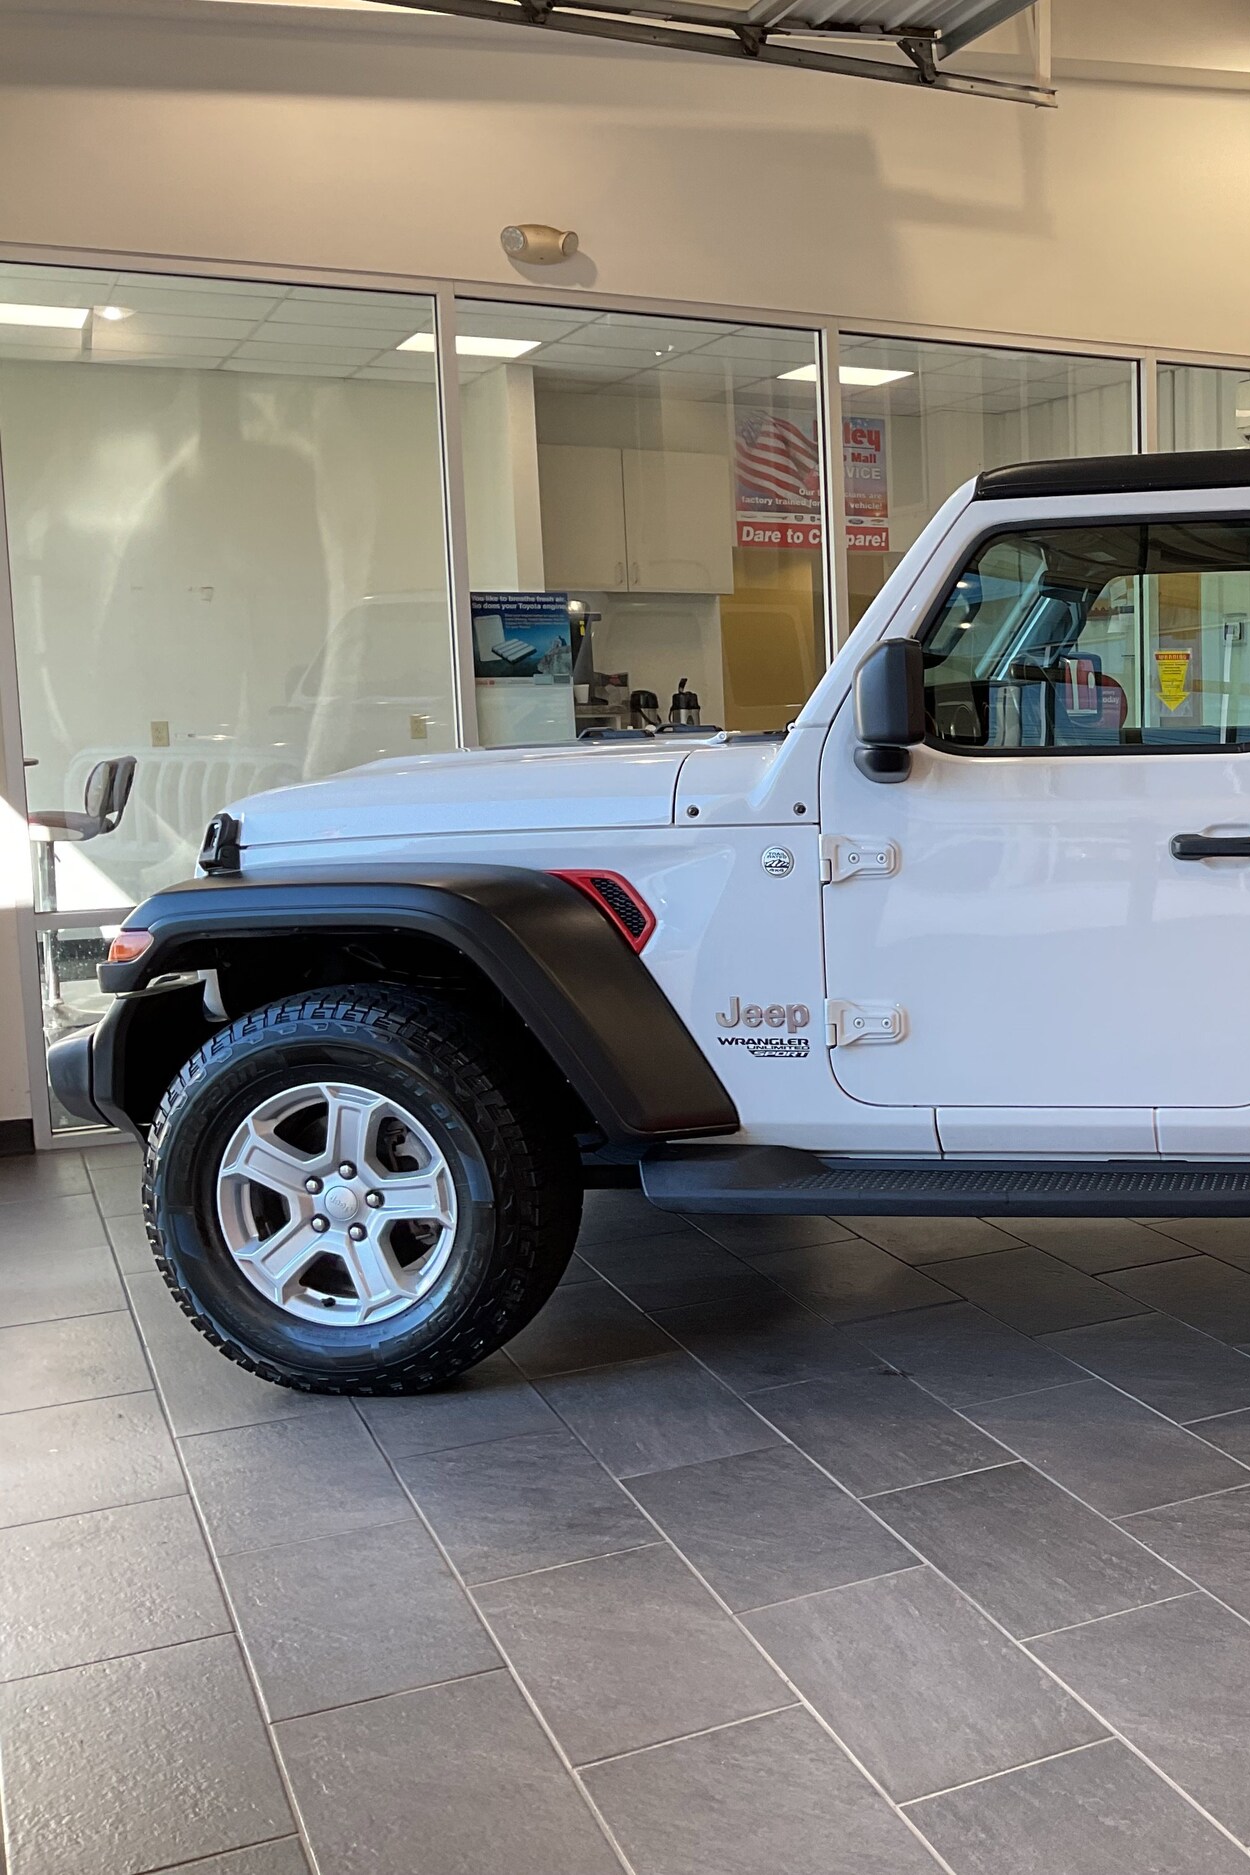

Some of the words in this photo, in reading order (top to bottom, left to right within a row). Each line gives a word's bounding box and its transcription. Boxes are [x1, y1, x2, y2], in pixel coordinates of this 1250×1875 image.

[851, 452, 877, 464] Mall
[799, 488, 815, 496] Our
[741, 496, 772, 506] factory
[776, 497, 807, 507] trained
[742, 526, 781, 543] Dare
[787, 529, 804, 544] to
[808, 528, 887, 547] Cpare!
[518, 603, 542, 611] Toyota
[715, 996, 810, 1034] Jeep
[717, 1036, 810, 1046] WRANGLER
